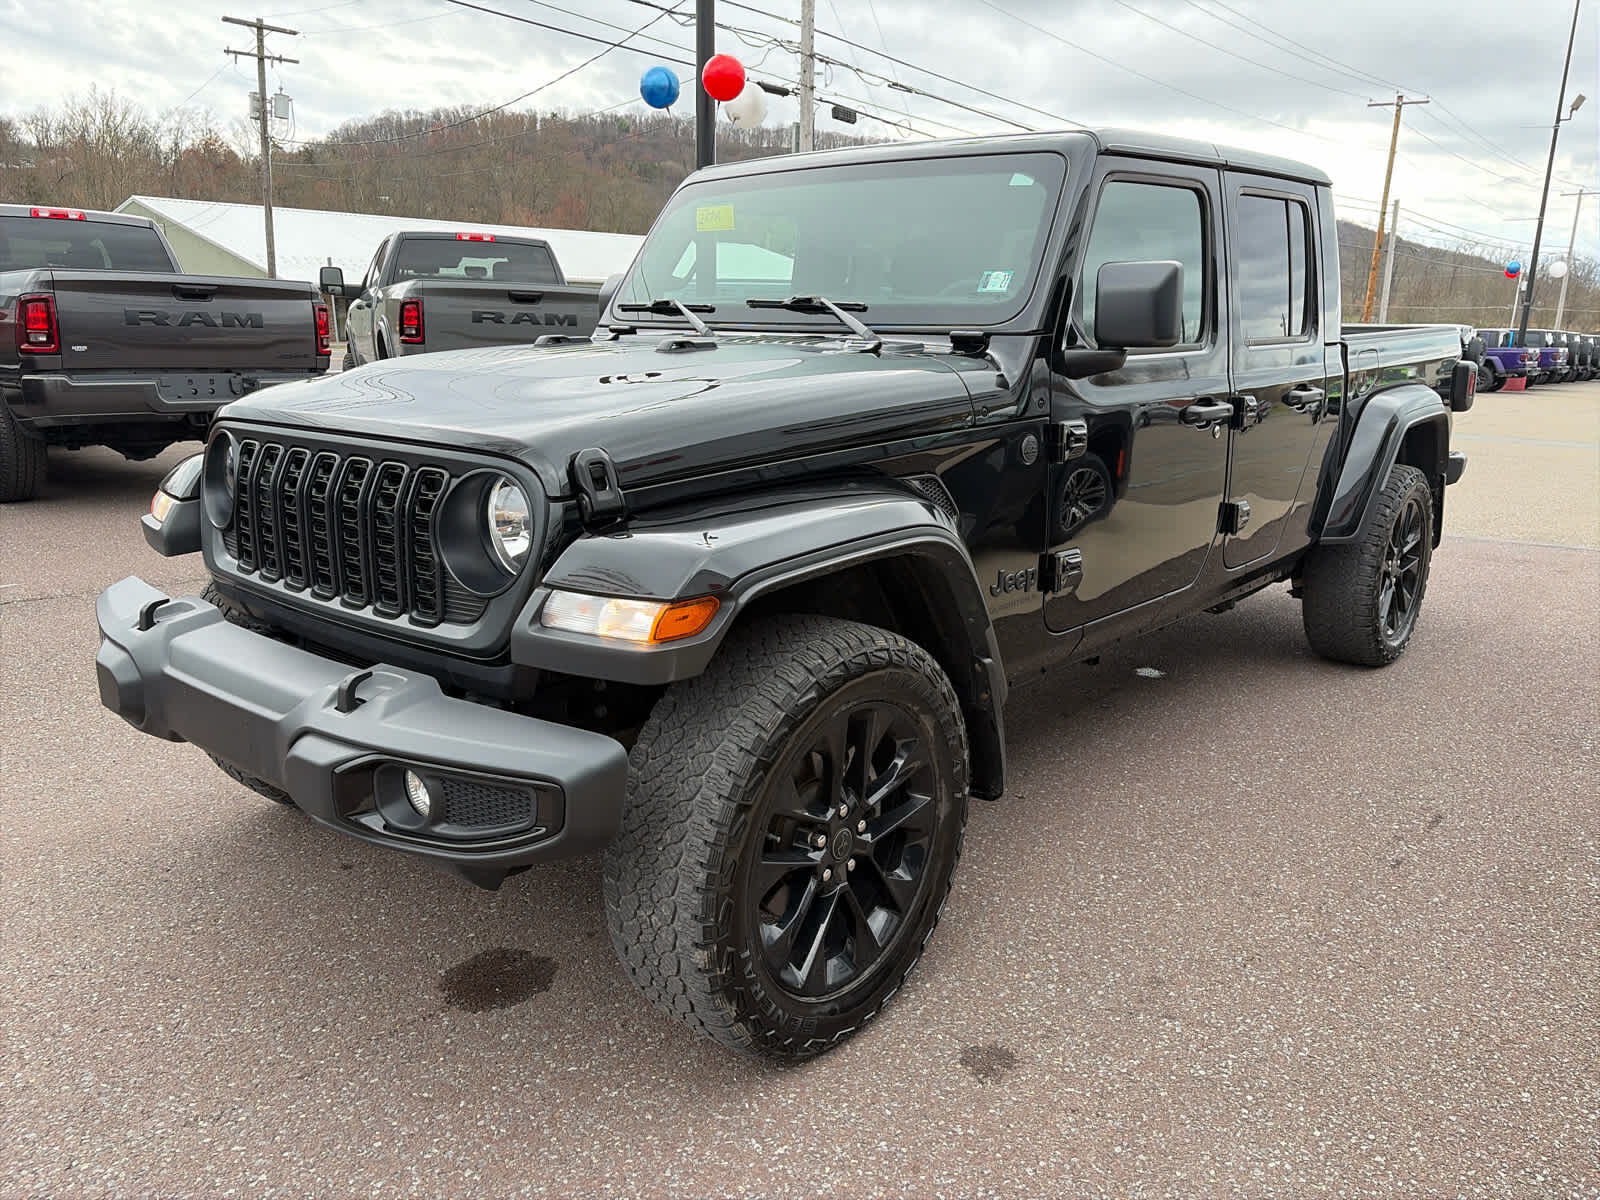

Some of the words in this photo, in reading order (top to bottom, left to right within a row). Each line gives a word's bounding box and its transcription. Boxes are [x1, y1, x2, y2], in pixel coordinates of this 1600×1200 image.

[124, 309, 264, 329] RAM
[471, 310, 578, 327] RAM
[990, 568, 1037, 598] Jeep
